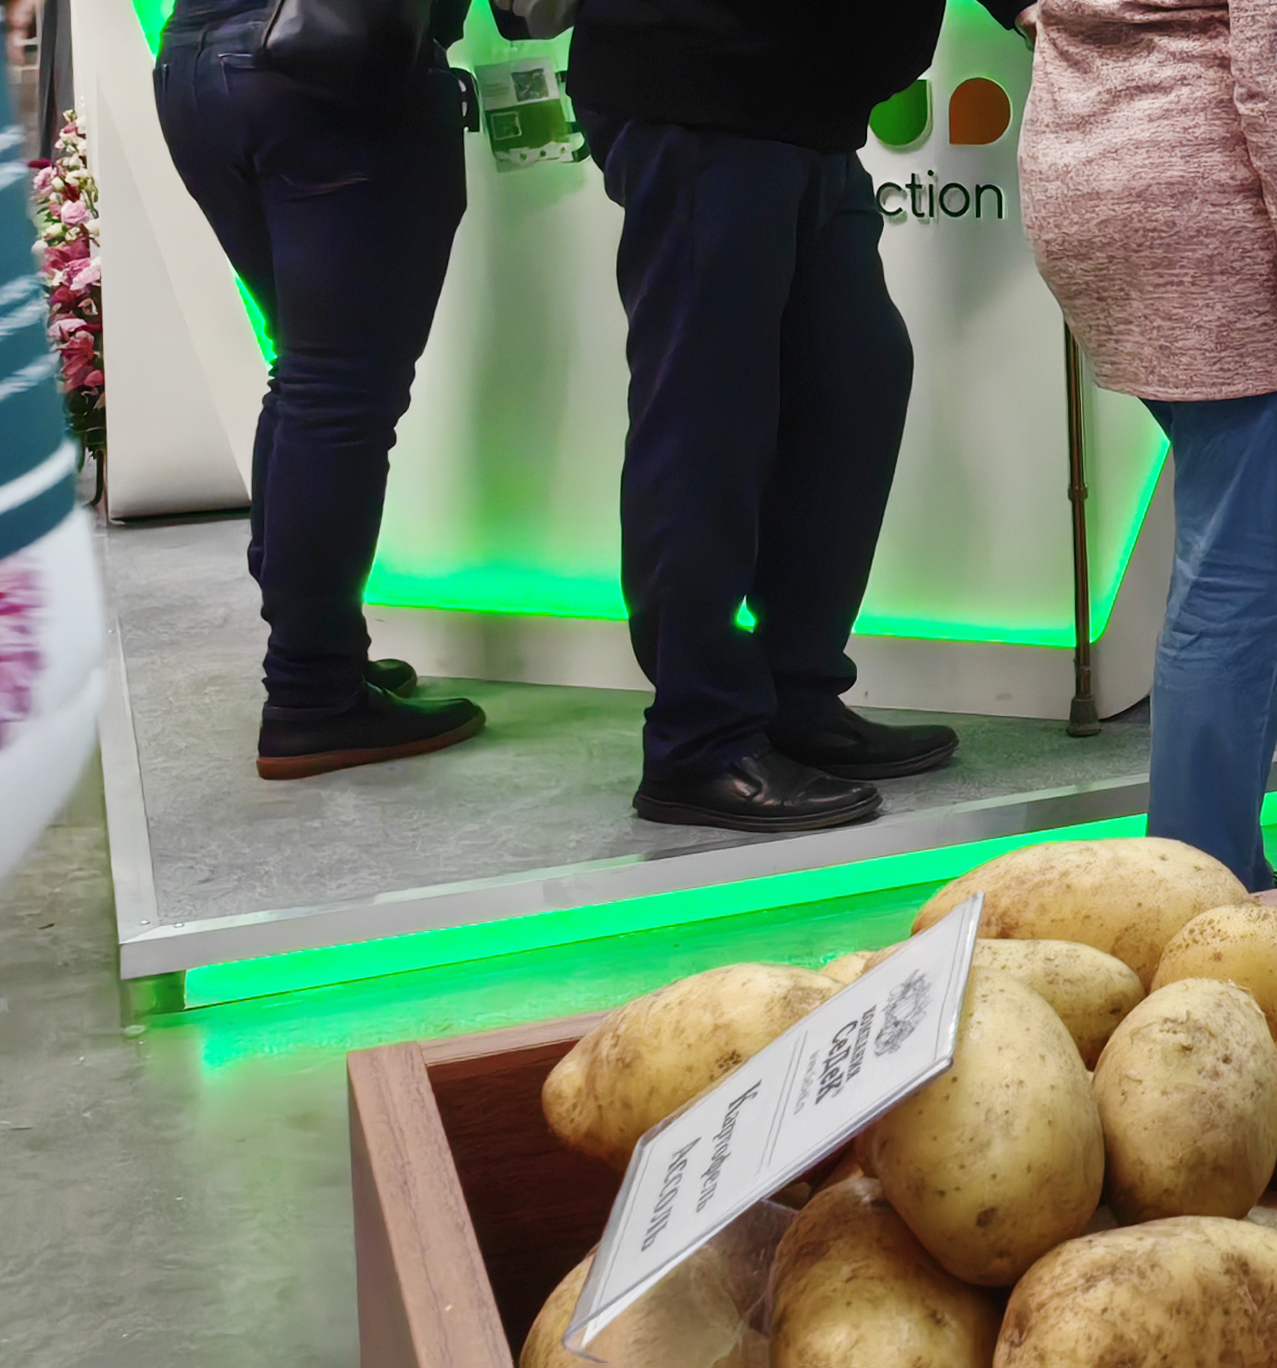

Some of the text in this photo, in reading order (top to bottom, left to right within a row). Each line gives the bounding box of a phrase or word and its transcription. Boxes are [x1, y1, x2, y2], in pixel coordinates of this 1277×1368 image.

[875, 169, 1004, 221] ction
[641, 1137, 702, 1252] Ассоль
[696, 1079, 762, 1213] Картофель
